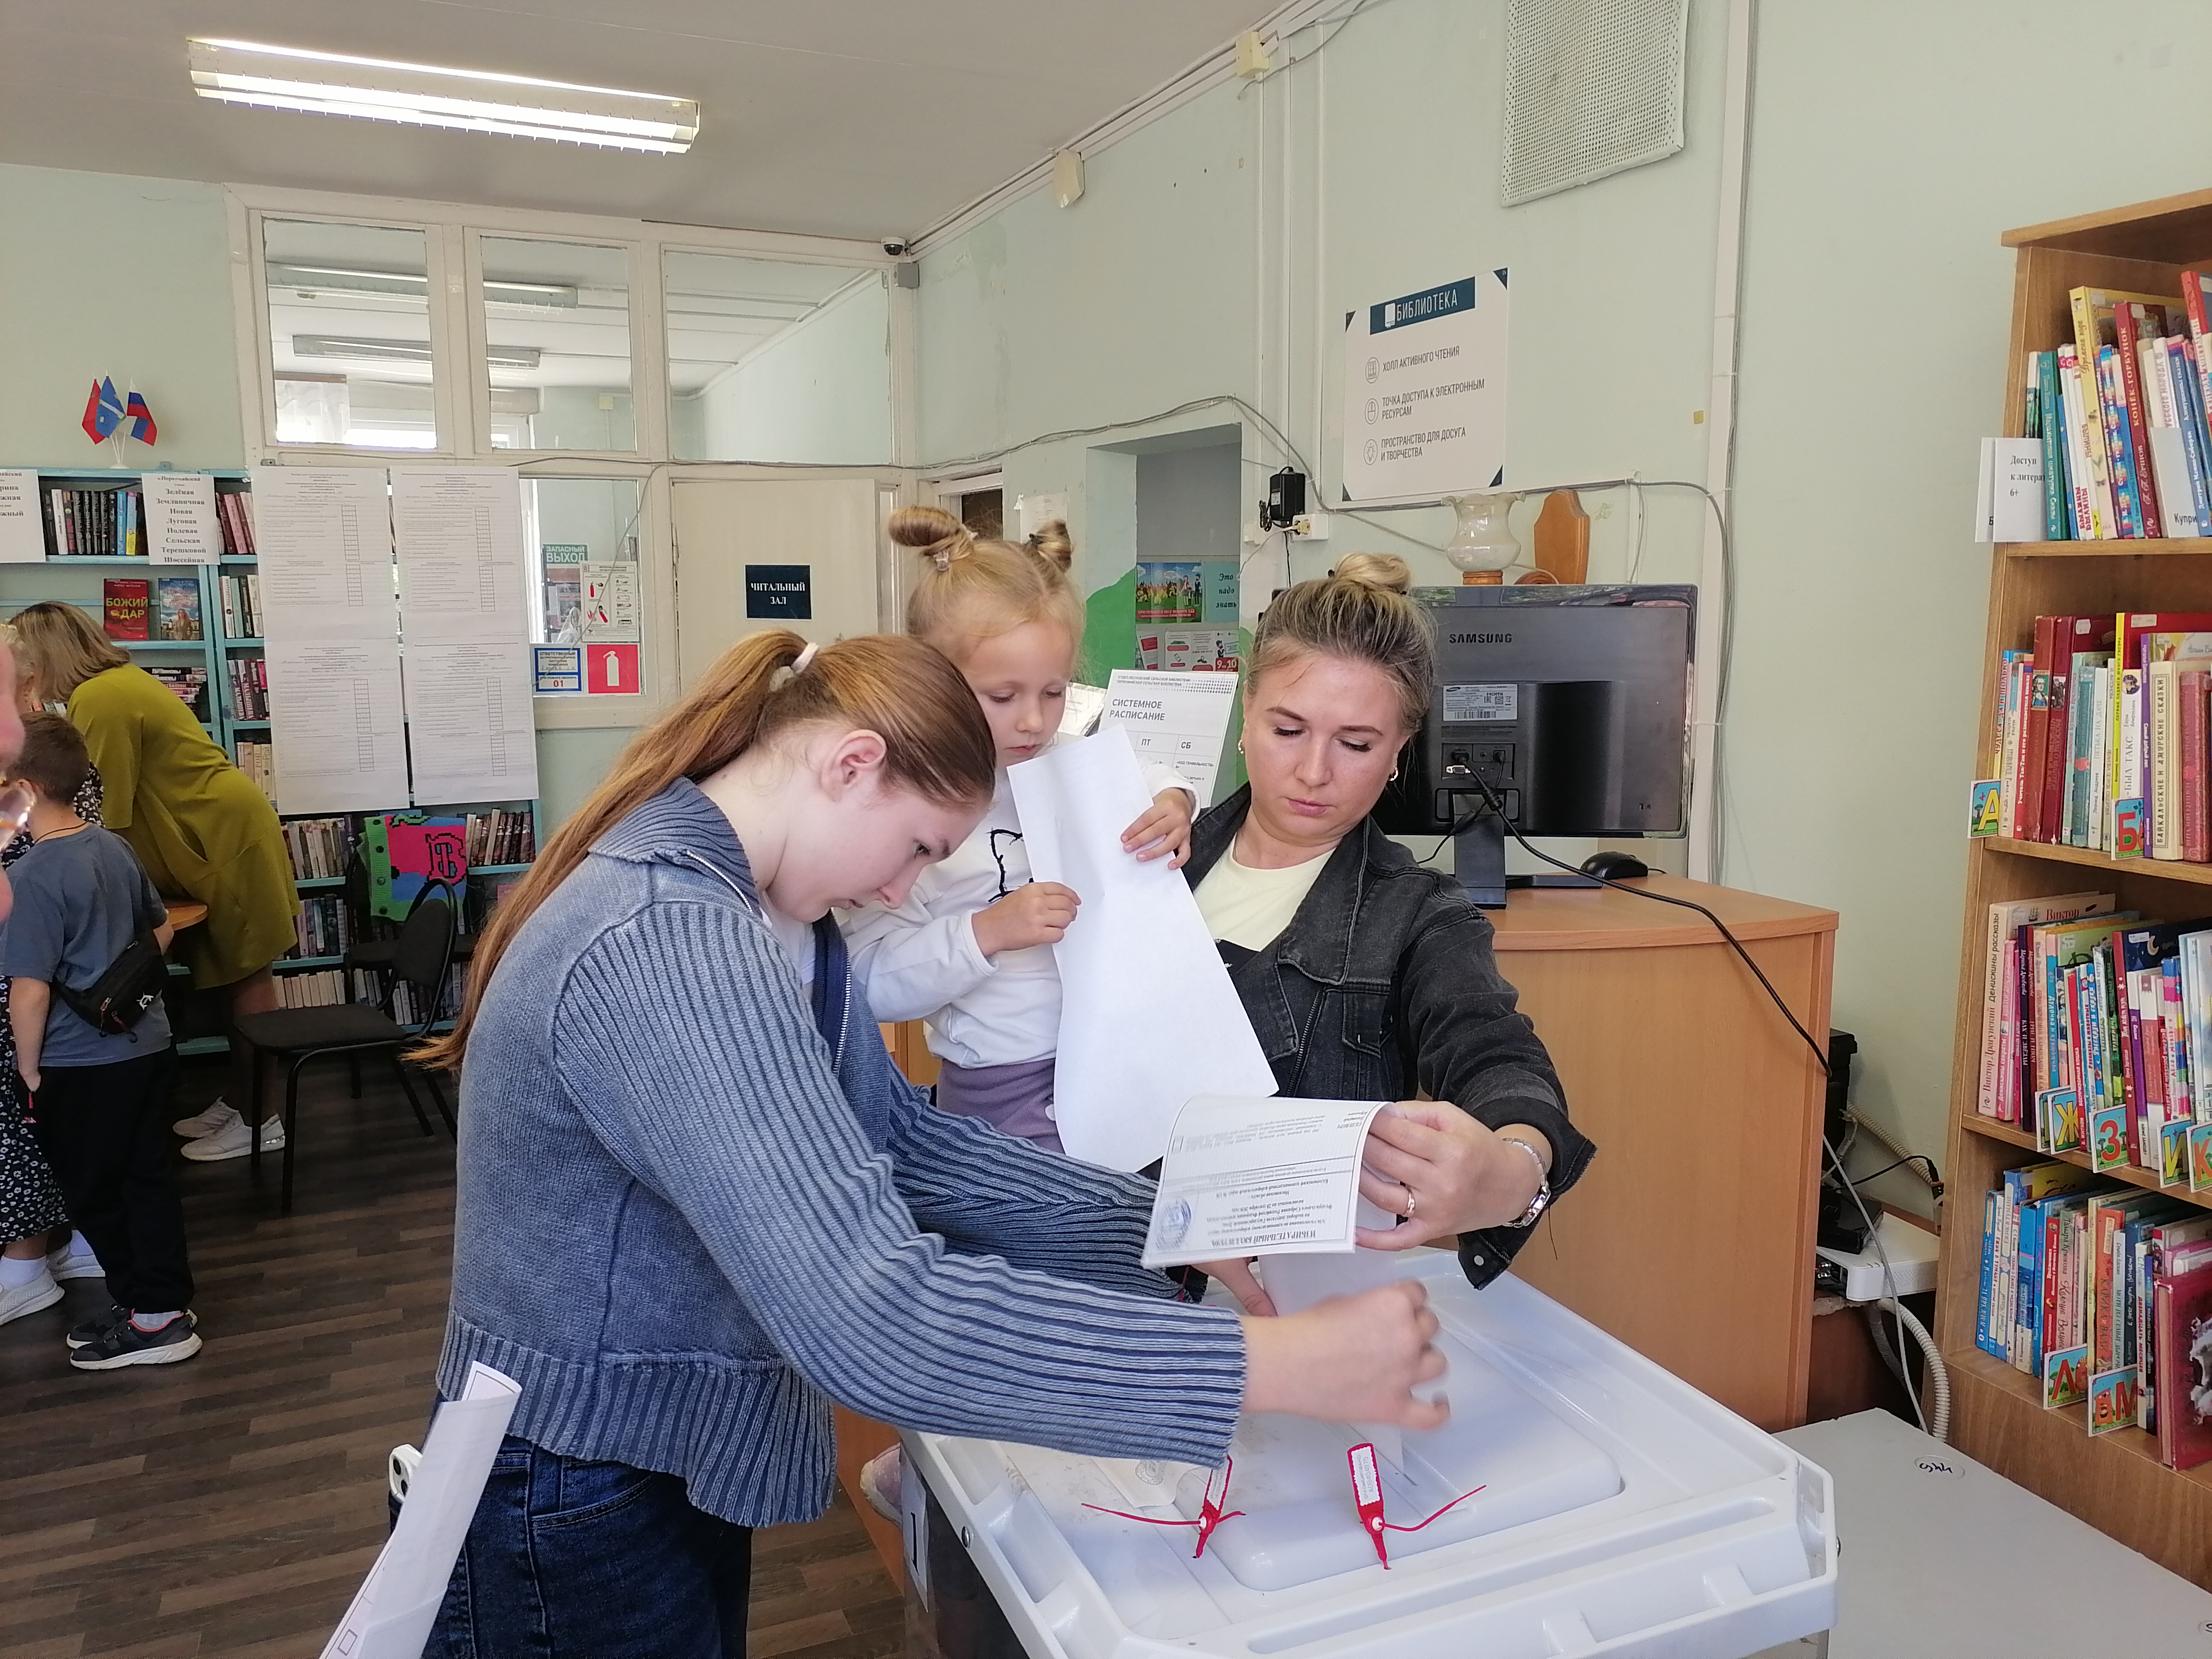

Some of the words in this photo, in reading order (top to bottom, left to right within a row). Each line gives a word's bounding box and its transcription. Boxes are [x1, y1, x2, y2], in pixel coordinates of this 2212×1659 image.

[1397, 289, 1458, 321] БИБЛИОТЕКА
[1383, 359, 1398, 372] ХОЛЛ
[1399, 351, 1434, 368] АКТИВНОГО
[1436, 346, 1459, 360] ЧТЕНИЯ
[2120, 327, 2140, 427] КОНЁК-ГОРБУНОК
[1382, 395, 1401, 408] ТОЧКА
[1401, 389, 1429, 405] ДОСТУПА
[1430, 389, 1434, 399] К
[1436, 378, 1485, 398] ЭЛЕКТРОННЫМ
[1382, 405, 1412, 420] РЕСУРСАМ
[2160, 394, 2172, 427] УССКОГО
[1381, 433, 1426, 448] ПРОСТРАНСТВО
[1427, 431, 1440, 442] ДЛЯ
[1441, 427, 1465, 440] ДОСУГА
[2082, 424, 2092, 458] БЫЛИНЫ
[1381, 451, 1385, 461] И
[1386, 446, 1422, 461] ТВОРЧЕСТВА
[2010, 456, 2037, 466] Доступ
[2017, 474, 2046, 483] литерат
[2010, 488, 2020, 497] 6+
[2081, 488, 2091, 531] БЫЛИНЫ
[2174, 513, 2197, 525] Купри
[546, 544, 585, 552] ЗАПАСНЫЙ
[546, 552, 585, 563] ВЫХОД
[1219, 573, 1234, 581] Это
[750, 580, 806, 593] ЧИТАЛЬНЫЙ
[1219, 586, 1234, 594] надо
[106, 596, 148, 607] БОЖИЙ
[770, 596, 787, 606] ЗАЛ
[120, 609, 145, 620] ДАР
[1449, 633, 1512, 644] SAMSUNG
[1227, 660, 1237, 668] 10
[1112, 698, 1162, 709] СИСТЕМНОЕ
[1999, 707, 2004, 718] ДА
[1109, 709, 1165, 721] РАСПИСАНИЕ
[2096, 721, 2101, 732] НА
[2125, 736, 2133, 763] ТАКС
[1978, 789, 2000, 831] А
[2118, 812, 2138, 852] Б
[2046, 908, 2079, 921] Виктор
[1989, 953, 1997, 1003] Денискины
[1985, 1008, 1996, 1060] Драгунский
[1983, 1060, 1995, 1092] Виктор
[2054, 1102, 2079, 1146] Ж
[2100, 1120, 2121, 1161] З
[2164, 1133, 2187, 1178] И
[2193, 1138, 2212, 1182] К
[2062, 1244, 2070, 1275] Крюкова
[2052, 1359, 2076, 1401] Л
[2115, 1378, 2138, 1421] М
